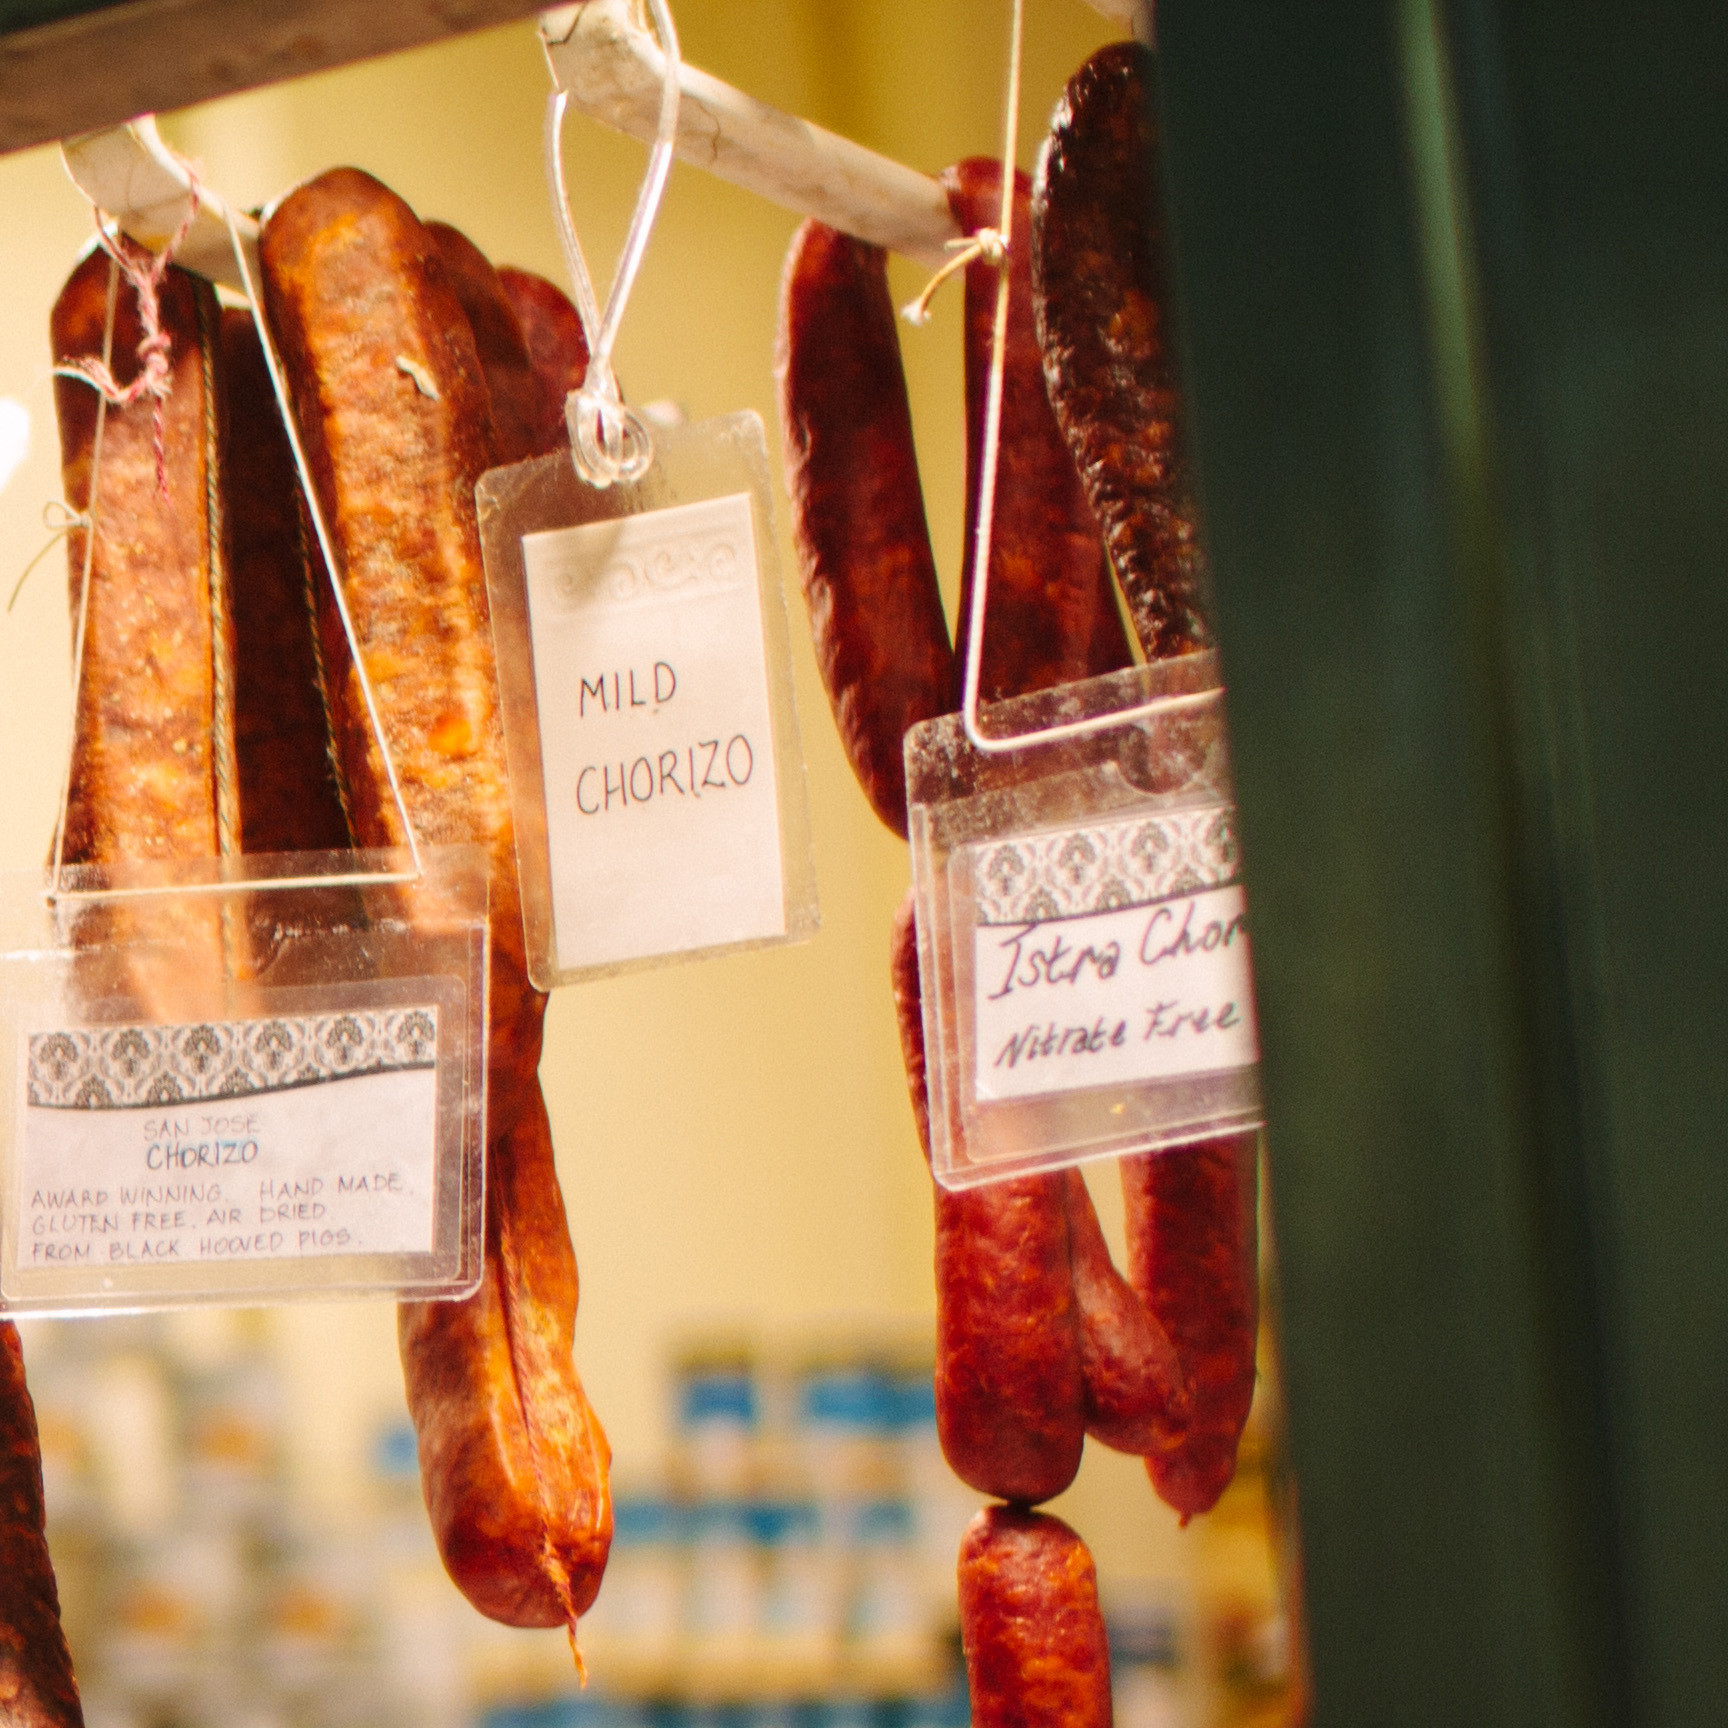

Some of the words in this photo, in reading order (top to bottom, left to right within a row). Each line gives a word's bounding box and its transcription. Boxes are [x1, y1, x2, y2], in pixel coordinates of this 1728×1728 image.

[579, 660, 678, 718] MILD
[575, 733, 754, 816] CHORIZO
[988, 926, 1121, 1000] Istra
[994, 1017, 1125, 1069] Nitrate
[1145, 1000, 1242, 1041] Free
[143, 1117, 190, 1142] SAN
[146, 1139, 259, 1171] CHORIZO
[31, 1188, 110, 1209] AWARD
[259, 1177, 324, 1201] HAND
[32, 1210, 118, 1236] GLUTEN
[206, 1206, 243, 1225] AIR
[32, 1240, 91, 1264] FROM
[108, 1237, 180, 1261] BLACK
